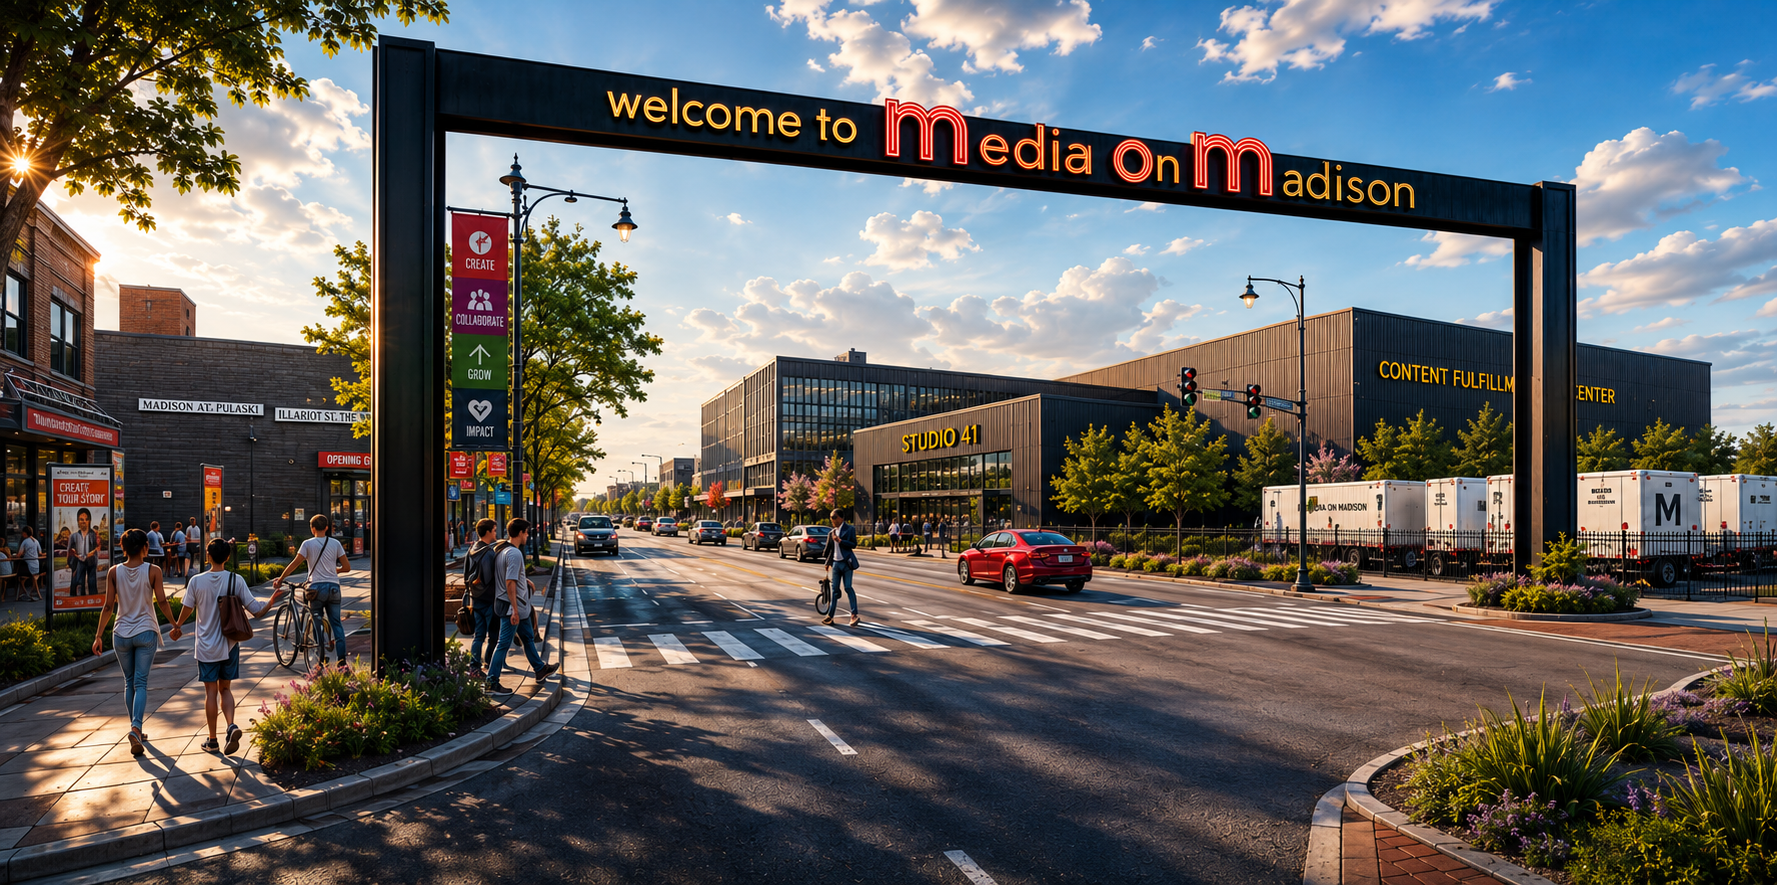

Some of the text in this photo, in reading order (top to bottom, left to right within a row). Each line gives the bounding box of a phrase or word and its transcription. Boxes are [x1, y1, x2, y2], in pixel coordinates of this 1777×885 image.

[607, 87, 801, 137] welcome
[816, 108, 857, 143] to
[465, 258, 495, 271] CREATE
[456, 313, 504, 327] COLLABORATE
[467, 368, 492, 380] GROW
[1379, 360, 1449, 386] CONTENT
[1453, 369, 1514, 393] FULFILLM
[143, 399, 194, 411] MADISON
[216, 403, 259, 414] PULASKI
[466, 425, 495, 437] IMPACT
[901, 424, 978, 454] STUDIO 41
[1327, 503, 1337, 512] ON
[1338, 503, 1367, 512] MADISON
[1655, 493, 1681, 526] M
